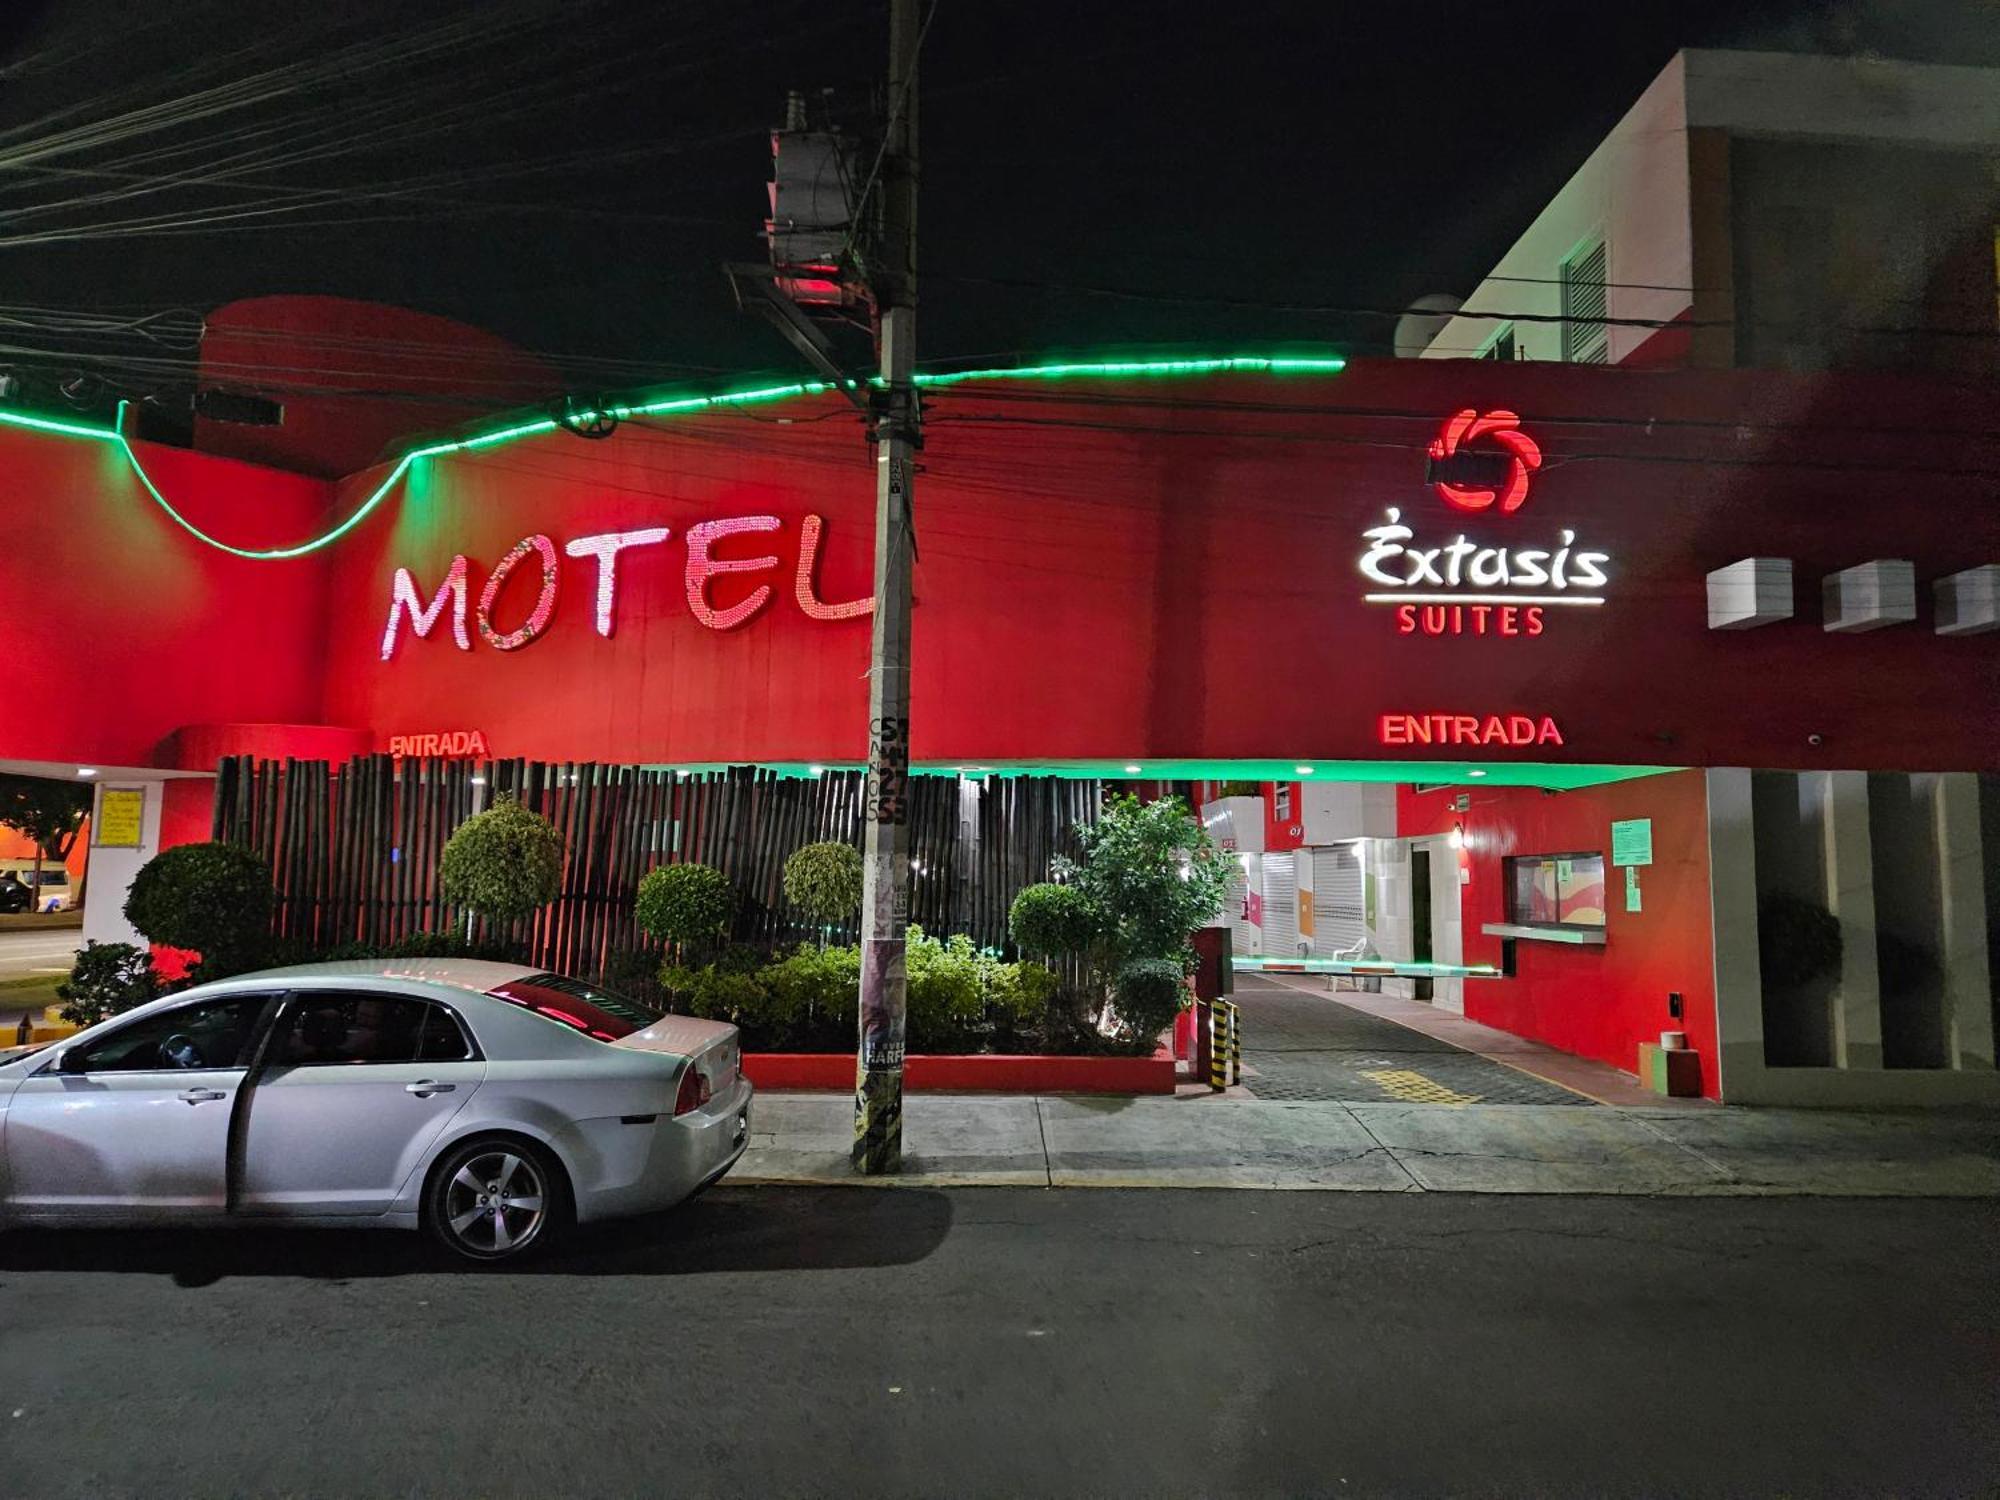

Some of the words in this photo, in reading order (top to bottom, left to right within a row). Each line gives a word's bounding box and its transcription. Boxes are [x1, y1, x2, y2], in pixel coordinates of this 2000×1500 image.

[380, 514, 877, 662] MOTEL
[1399, 605, 1544, 635] SUITES
[390, 730, 485, 759] ENTRADA
[1382, 714, 1564, 746] ENTRADA
